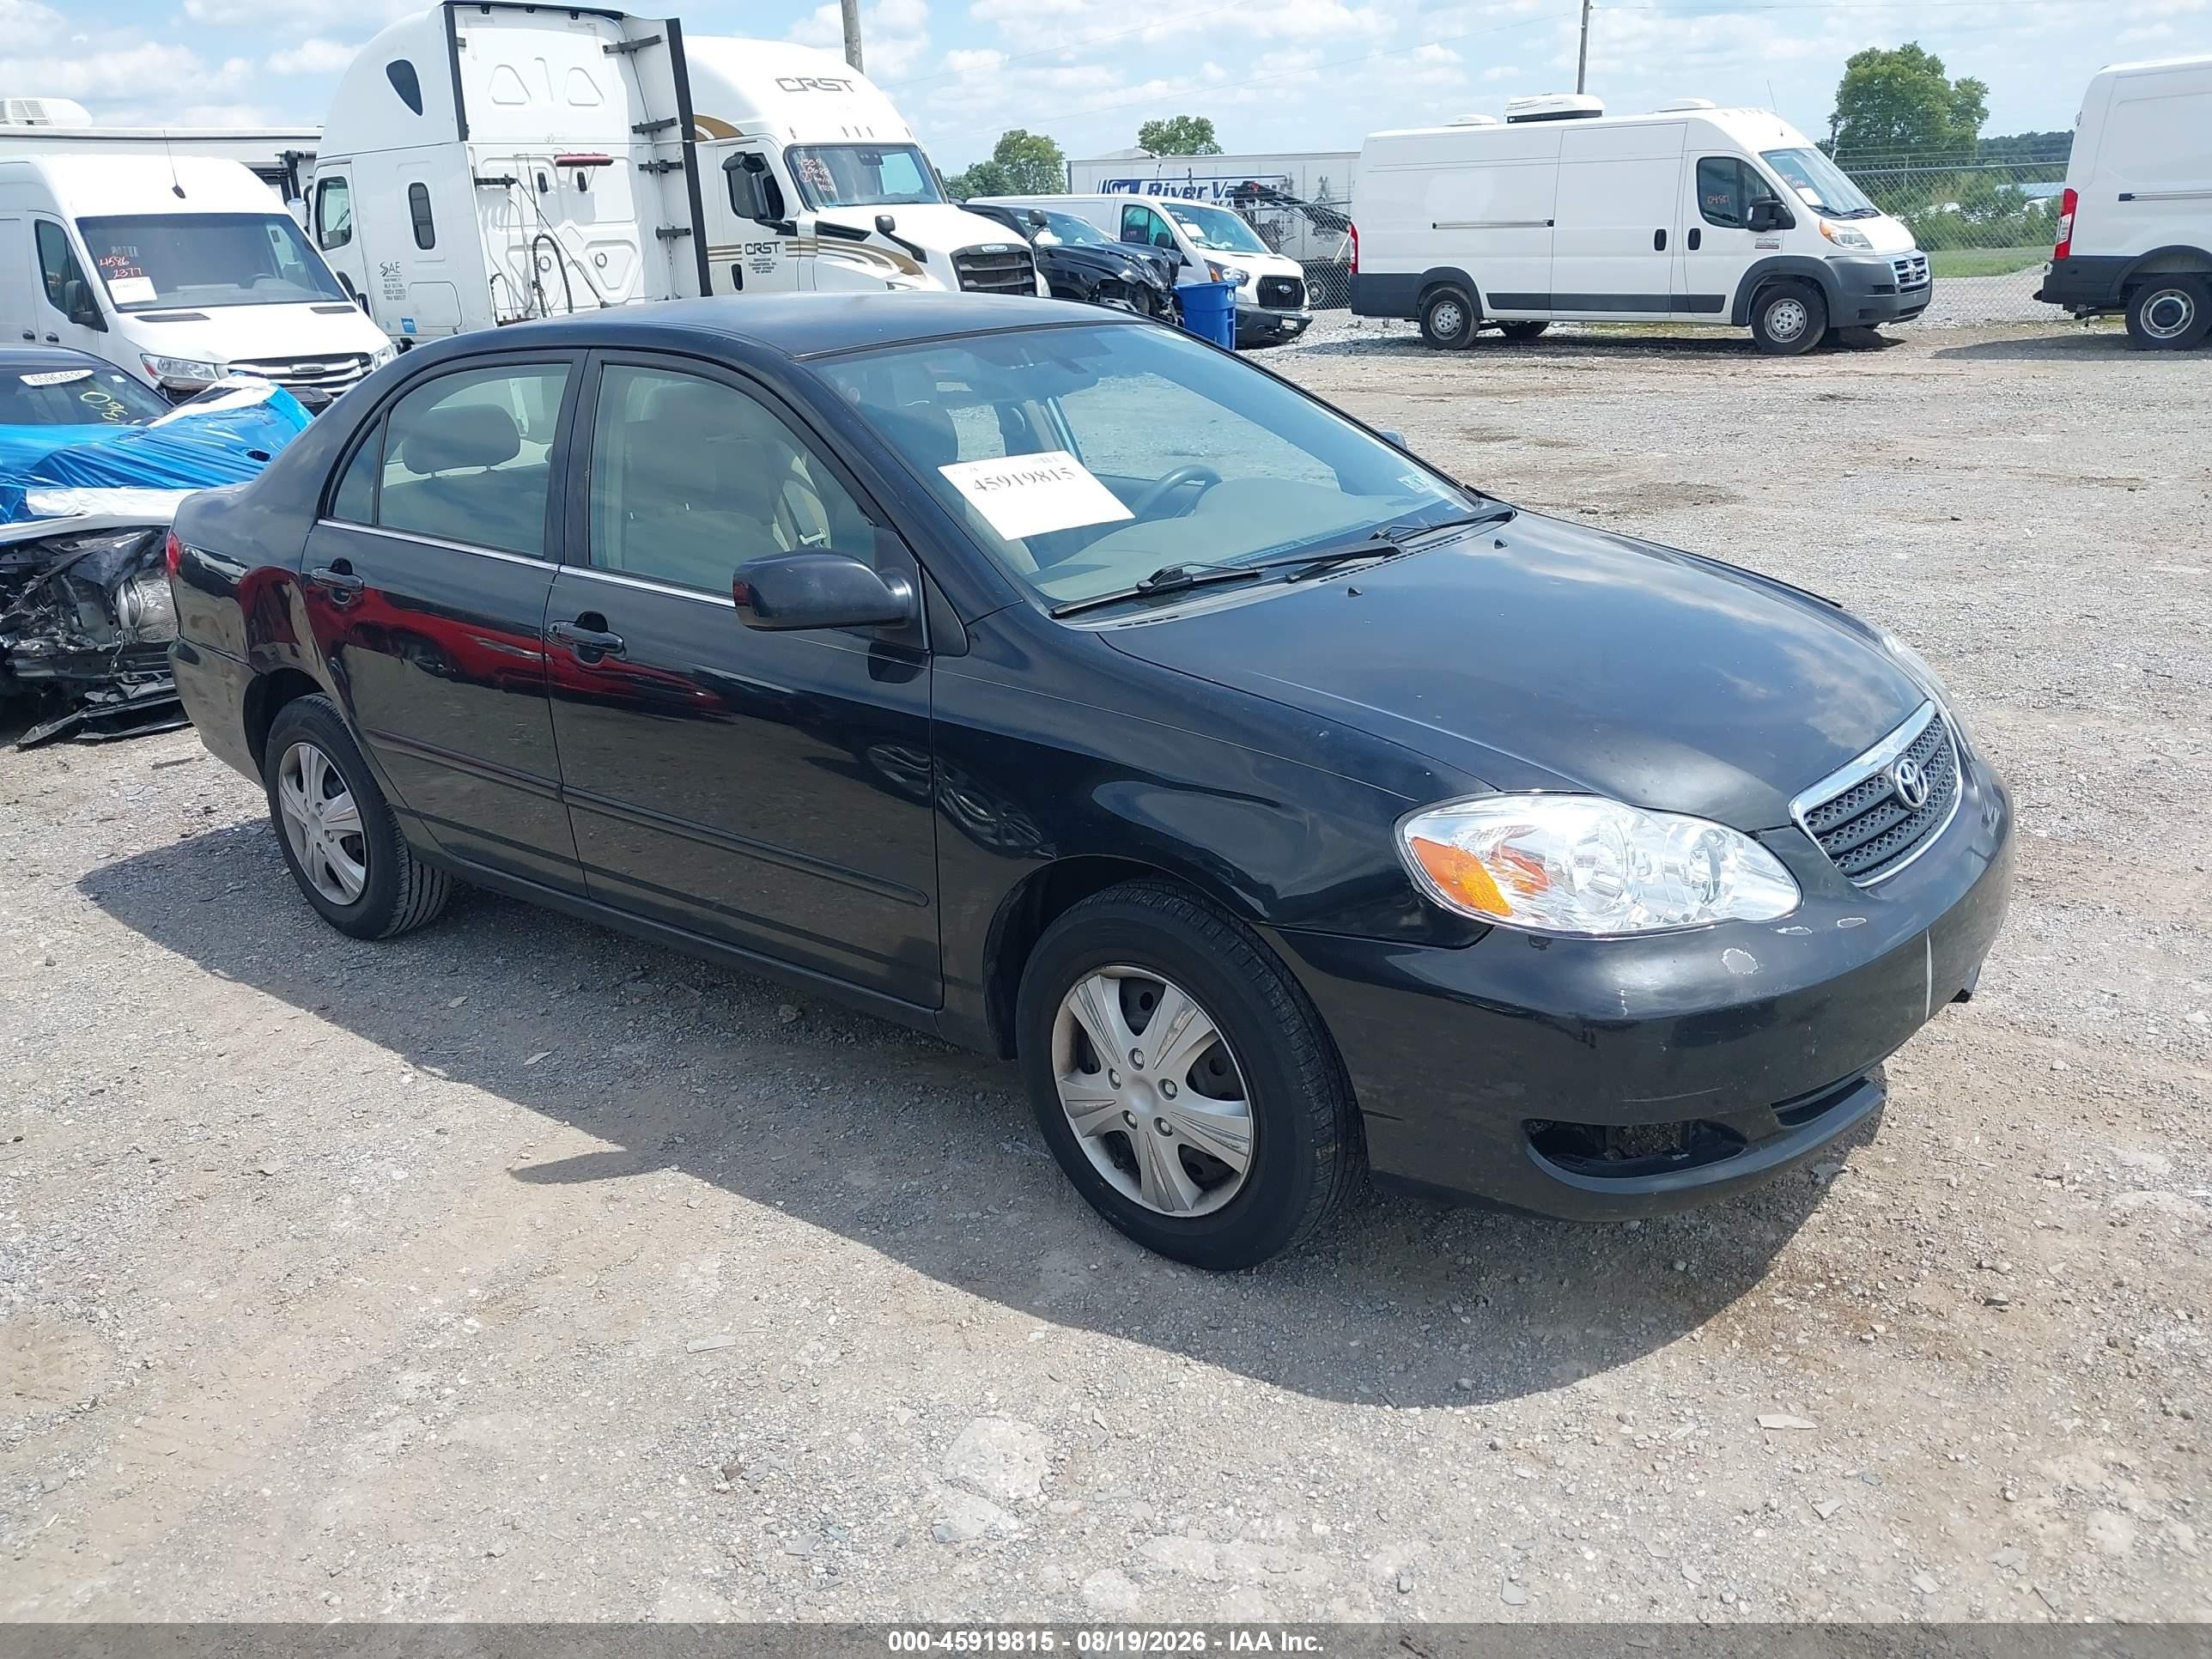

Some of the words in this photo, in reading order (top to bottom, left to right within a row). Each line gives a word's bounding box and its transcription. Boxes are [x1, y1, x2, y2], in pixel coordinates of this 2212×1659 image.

[775, 77, 854, 93] CRST
[1147, 182, 1208, 199] River
[744, 241, 781, 255] CRST
[380, 261, 400, 276] SAE
[974, 467, 1076, 492] 45919815
